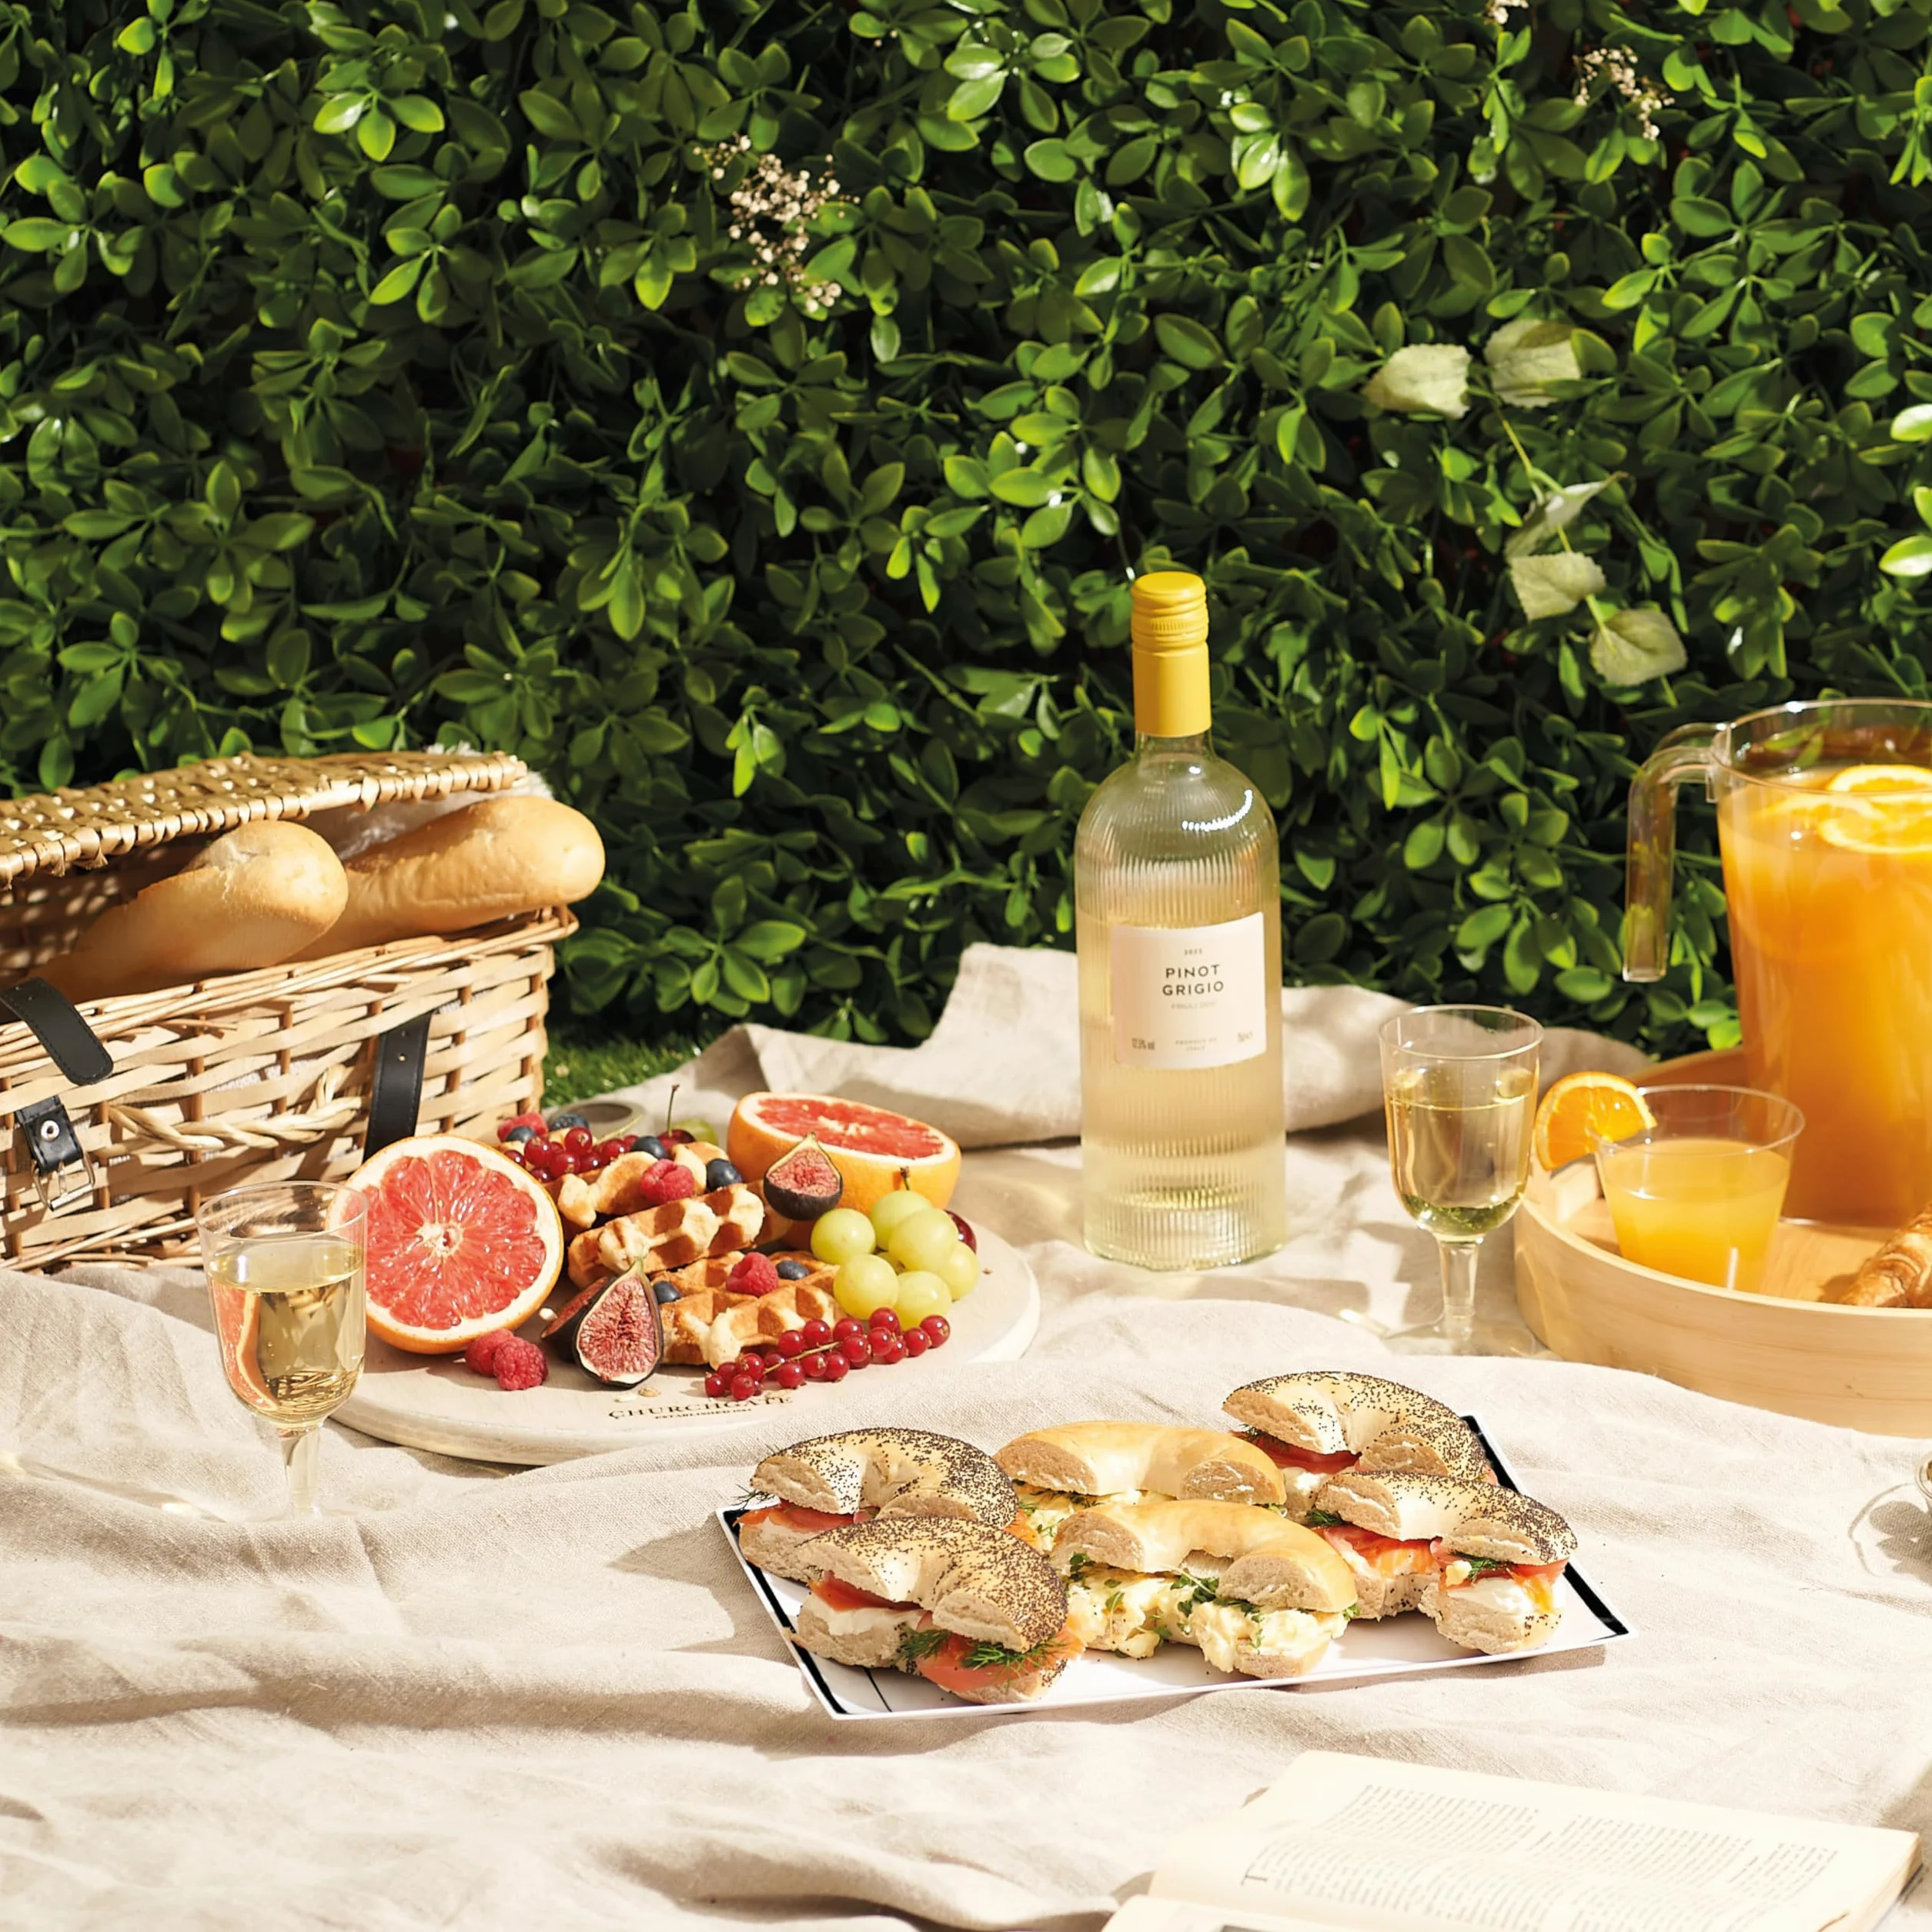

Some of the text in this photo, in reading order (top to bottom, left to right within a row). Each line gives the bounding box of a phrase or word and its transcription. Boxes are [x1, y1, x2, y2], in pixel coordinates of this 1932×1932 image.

[1165, 964, 1220, 978] PINOT
[1162, 981, 1224, 996] GRIGIO
[608, 1398, 793, 1419] CHURCHGATE
